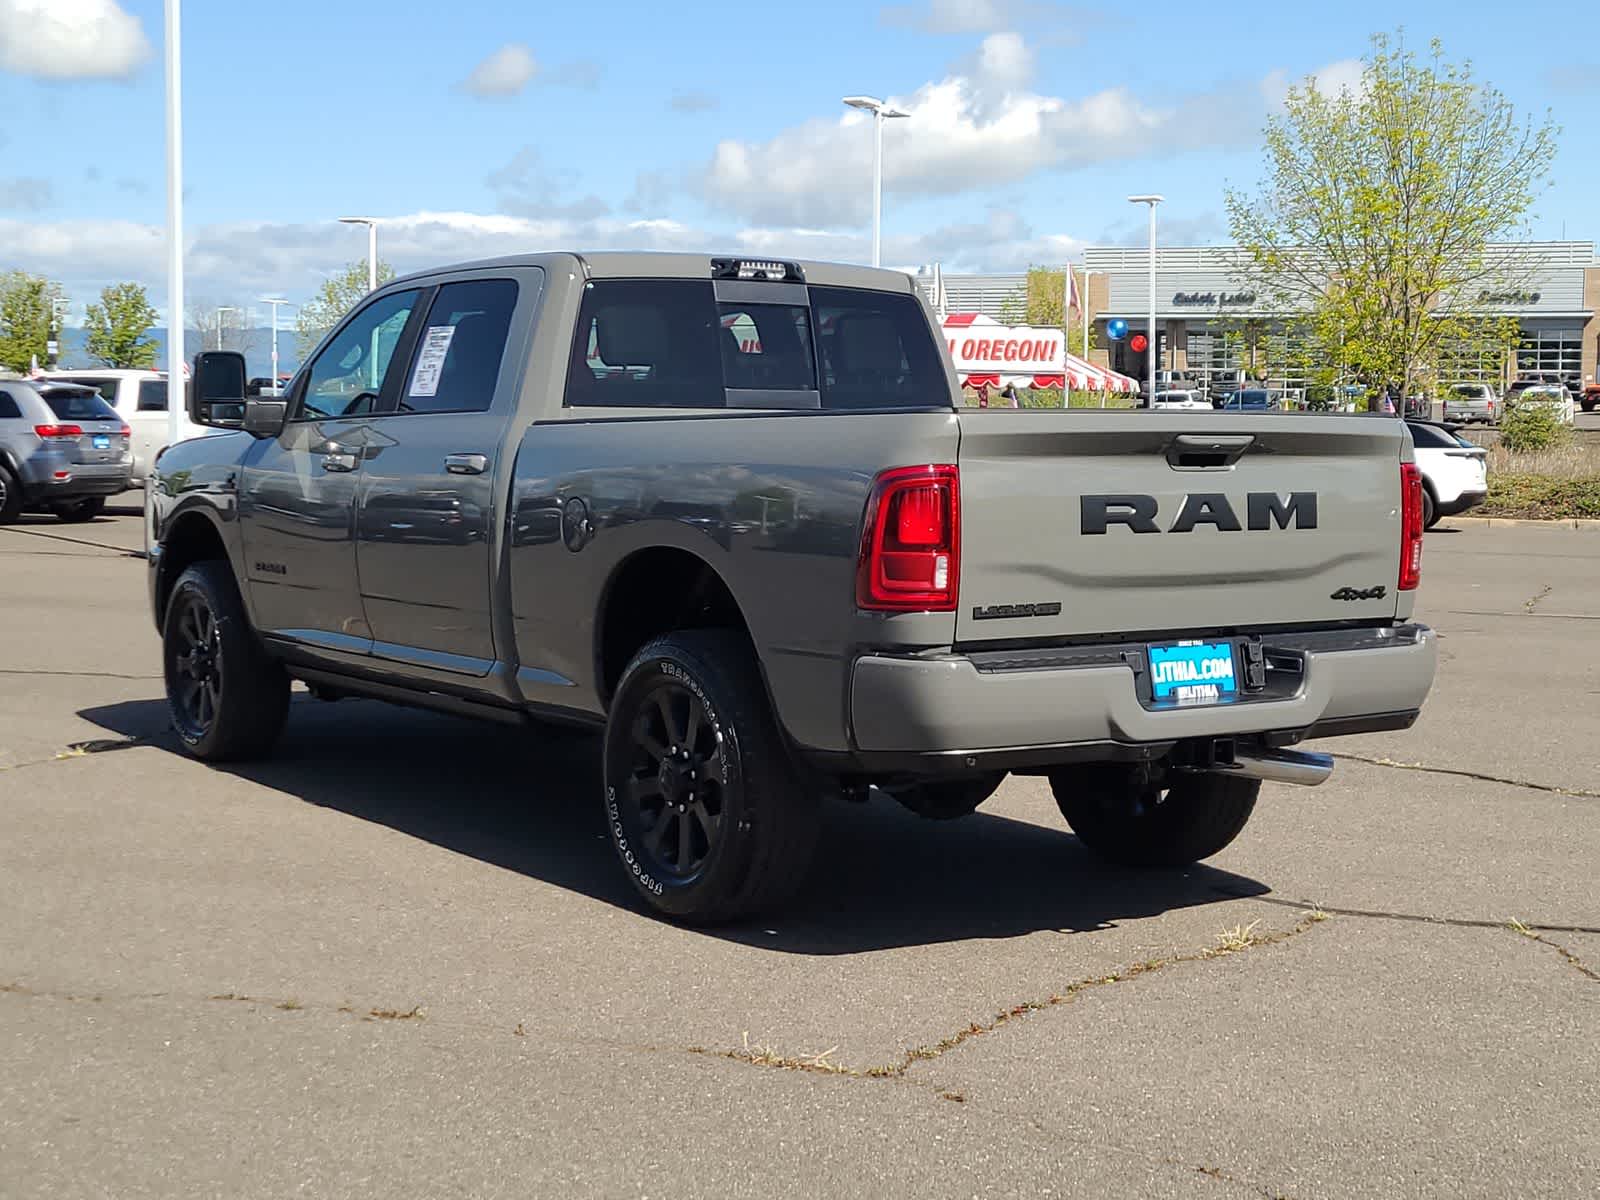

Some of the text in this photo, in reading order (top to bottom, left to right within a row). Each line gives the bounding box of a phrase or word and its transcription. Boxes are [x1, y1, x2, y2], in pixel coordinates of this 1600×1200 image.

[961, 339, 1057, 361] OREGON!
[1080, 492, 1317, 535] RAM
[1152, 657, 1234, 684] LITHIA.COM
